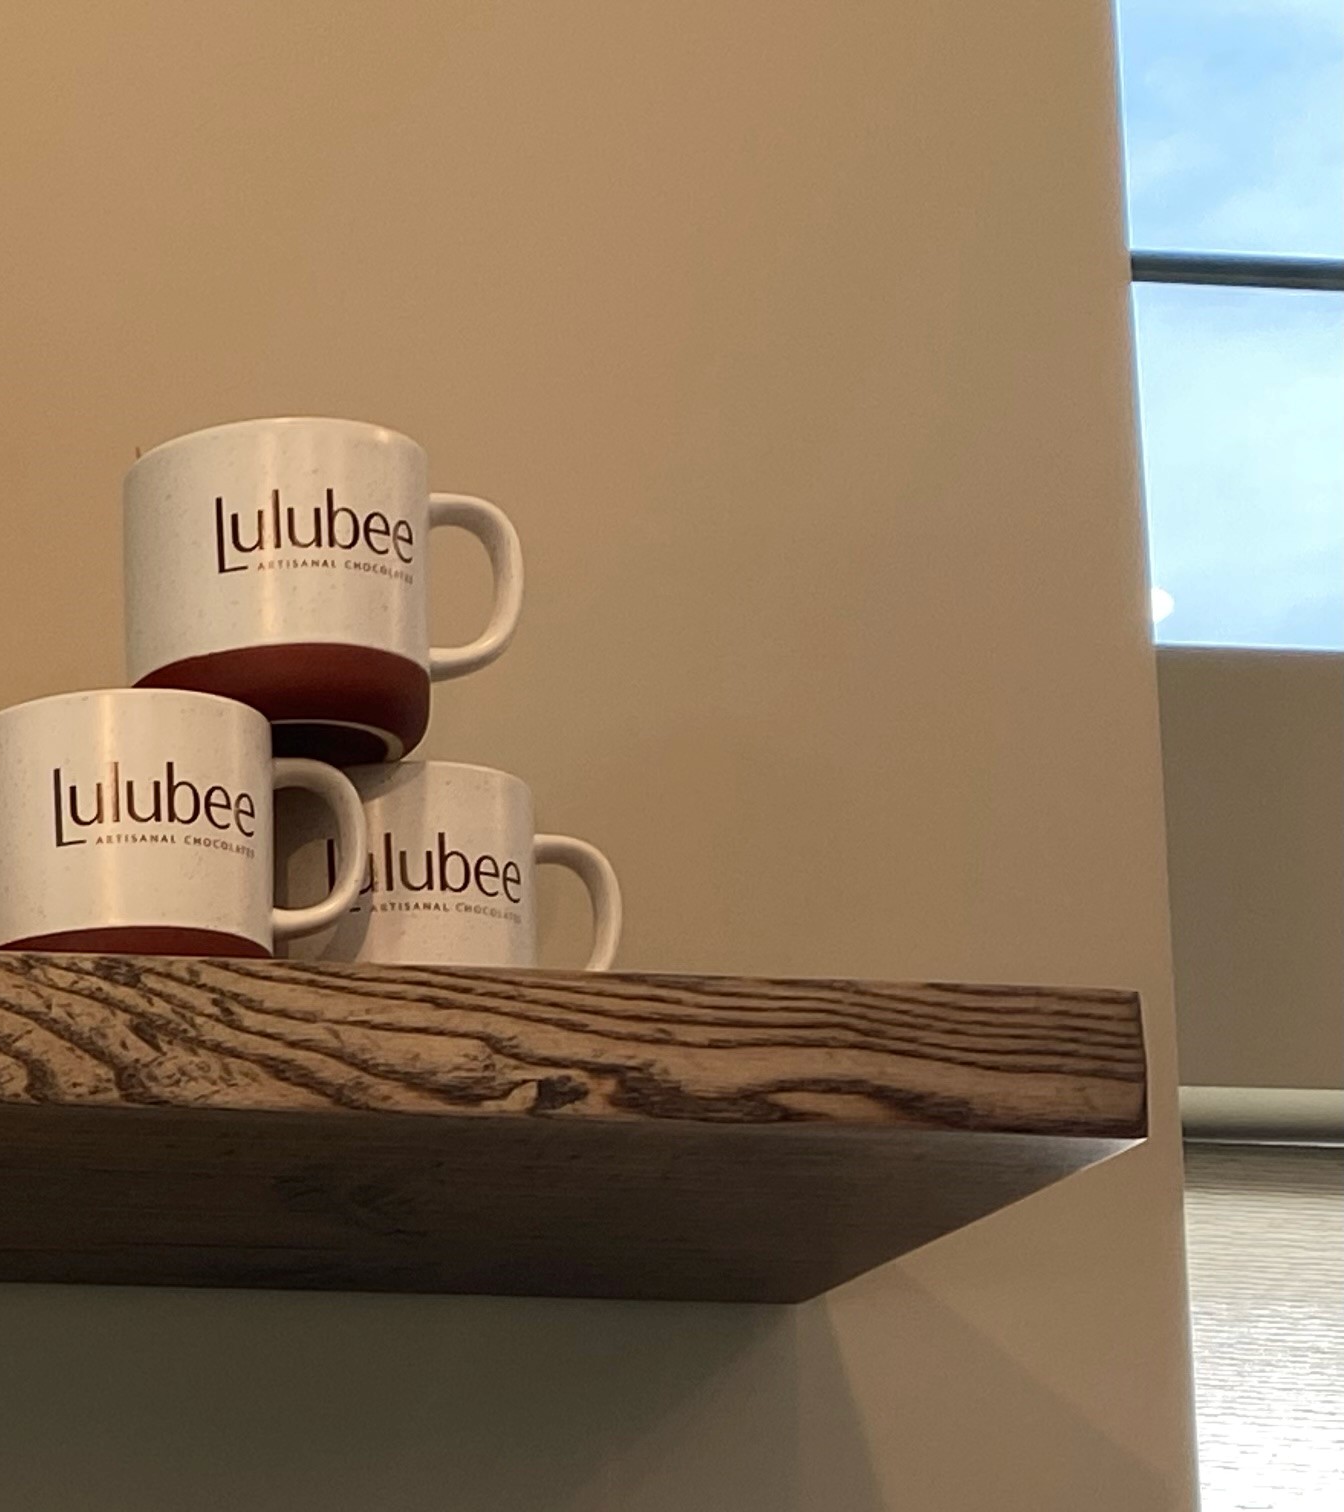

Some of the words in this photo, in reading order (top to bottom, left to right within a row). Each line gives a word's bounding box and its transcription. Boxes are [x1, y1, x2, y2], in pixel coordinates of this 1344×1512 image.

[215, 488, 413, 574] Lulubee
[257, 559, 337, 572] ARTISANAL
[54, 762, 255, 847] Lulubee
[96, 835, 176, 846] ARTISANAL
[371, 902, 450, 912] ARTISANAL
